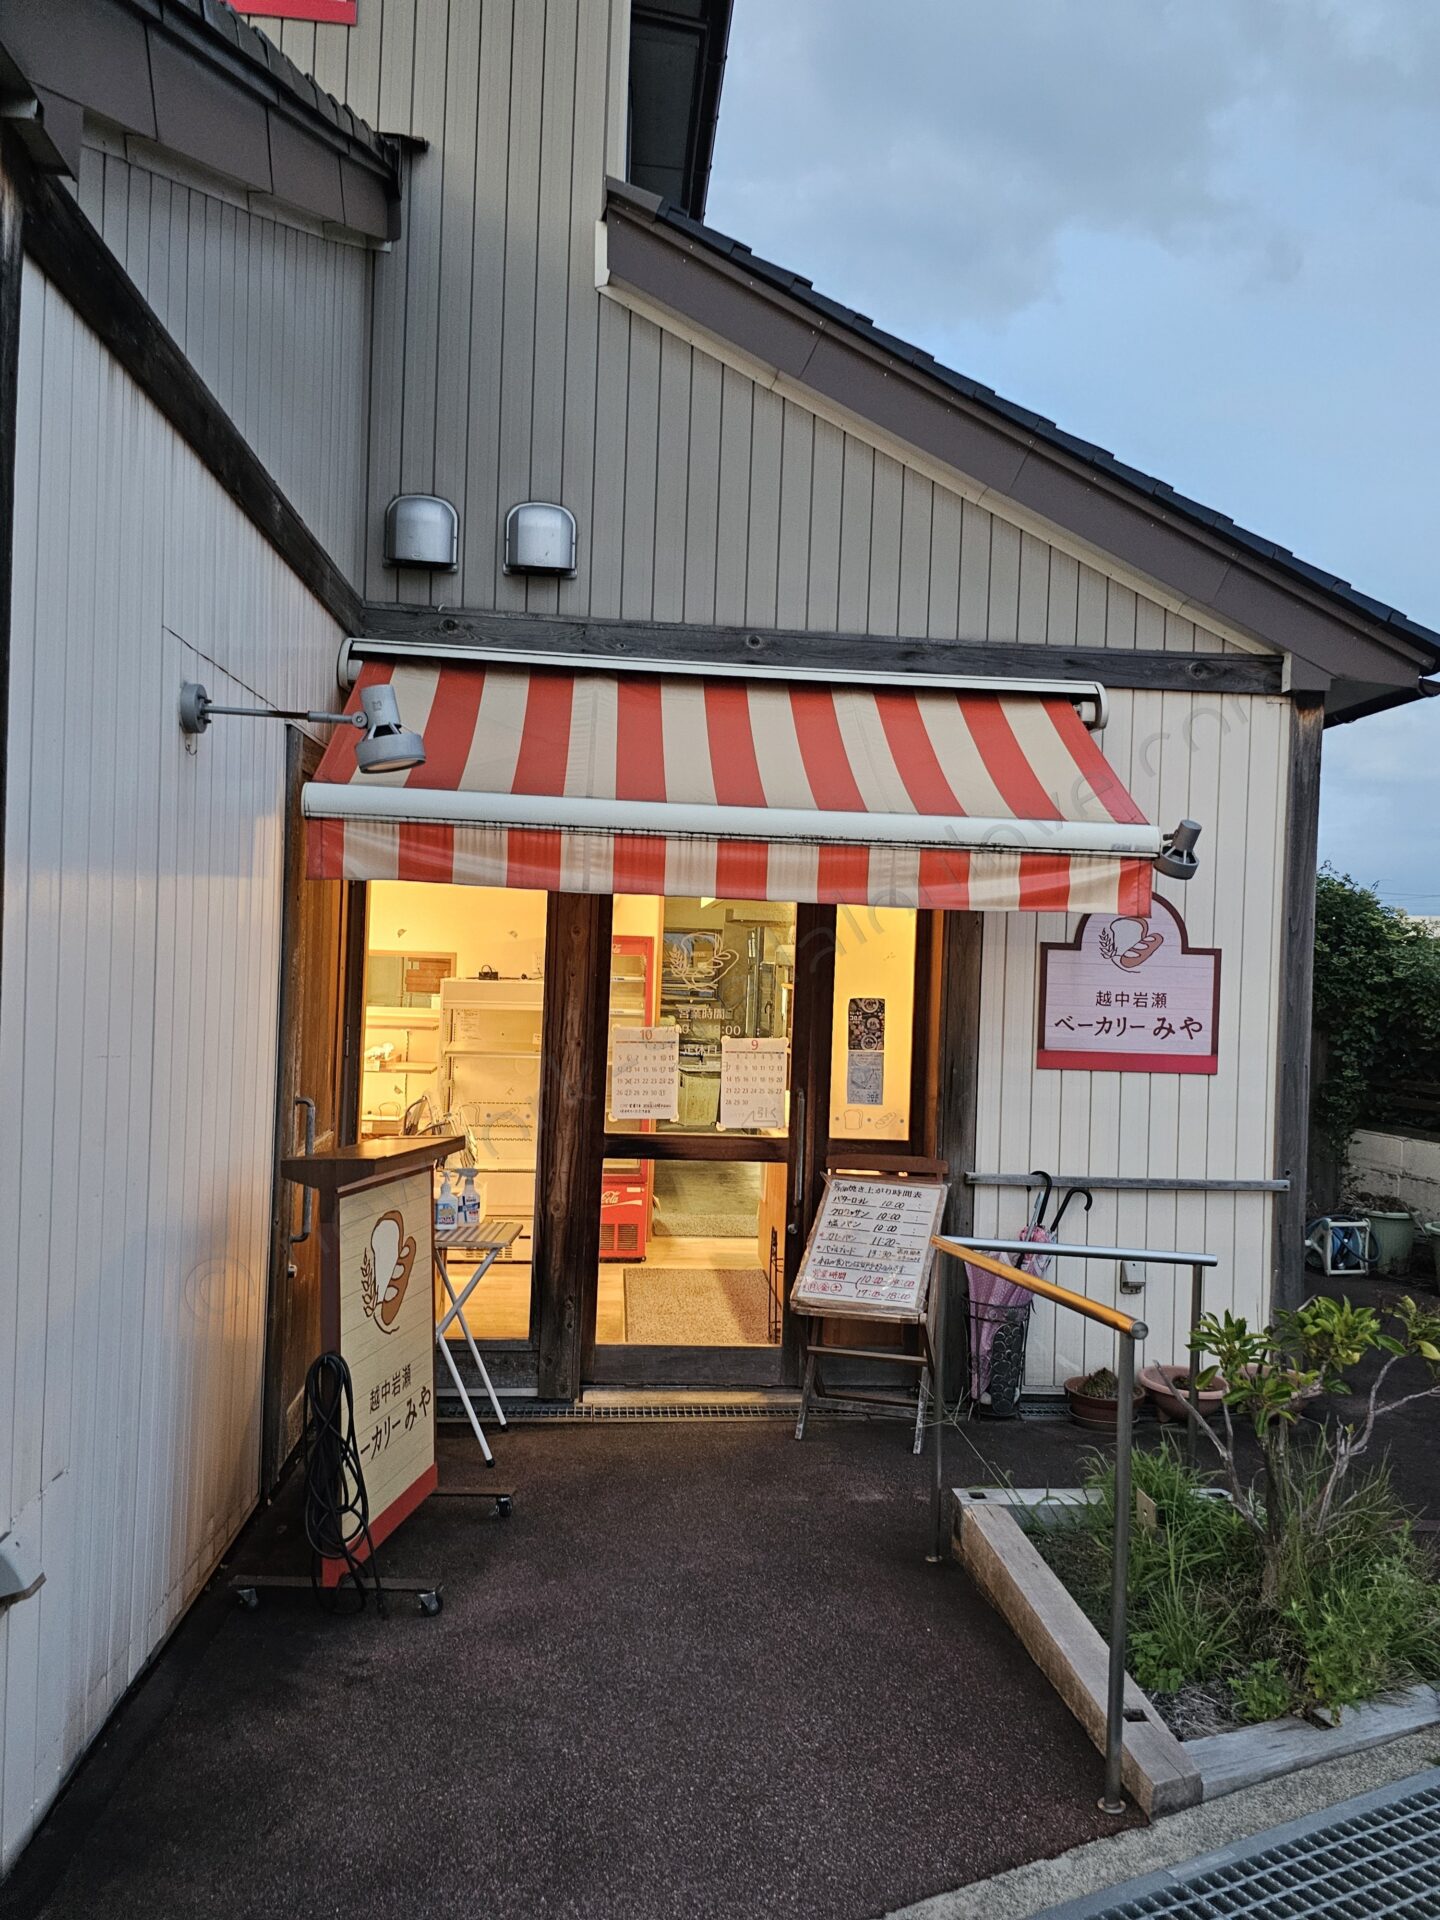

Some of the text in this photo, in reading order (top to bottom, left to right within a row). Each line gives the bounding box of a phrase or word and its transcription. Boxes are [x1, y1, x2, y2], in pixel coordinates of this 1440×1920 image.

[1095, 990, 1168, 1009] 越中岩瀬
[640, 1029, 653, 1040] 10
[751, 1040, 759, 1050] 9
[876, 1212, 901, 1220] 10:00
[873, 1224, 898, 1232] 10:00
[369, 1363, 411, 1414] 越中岩瀬
